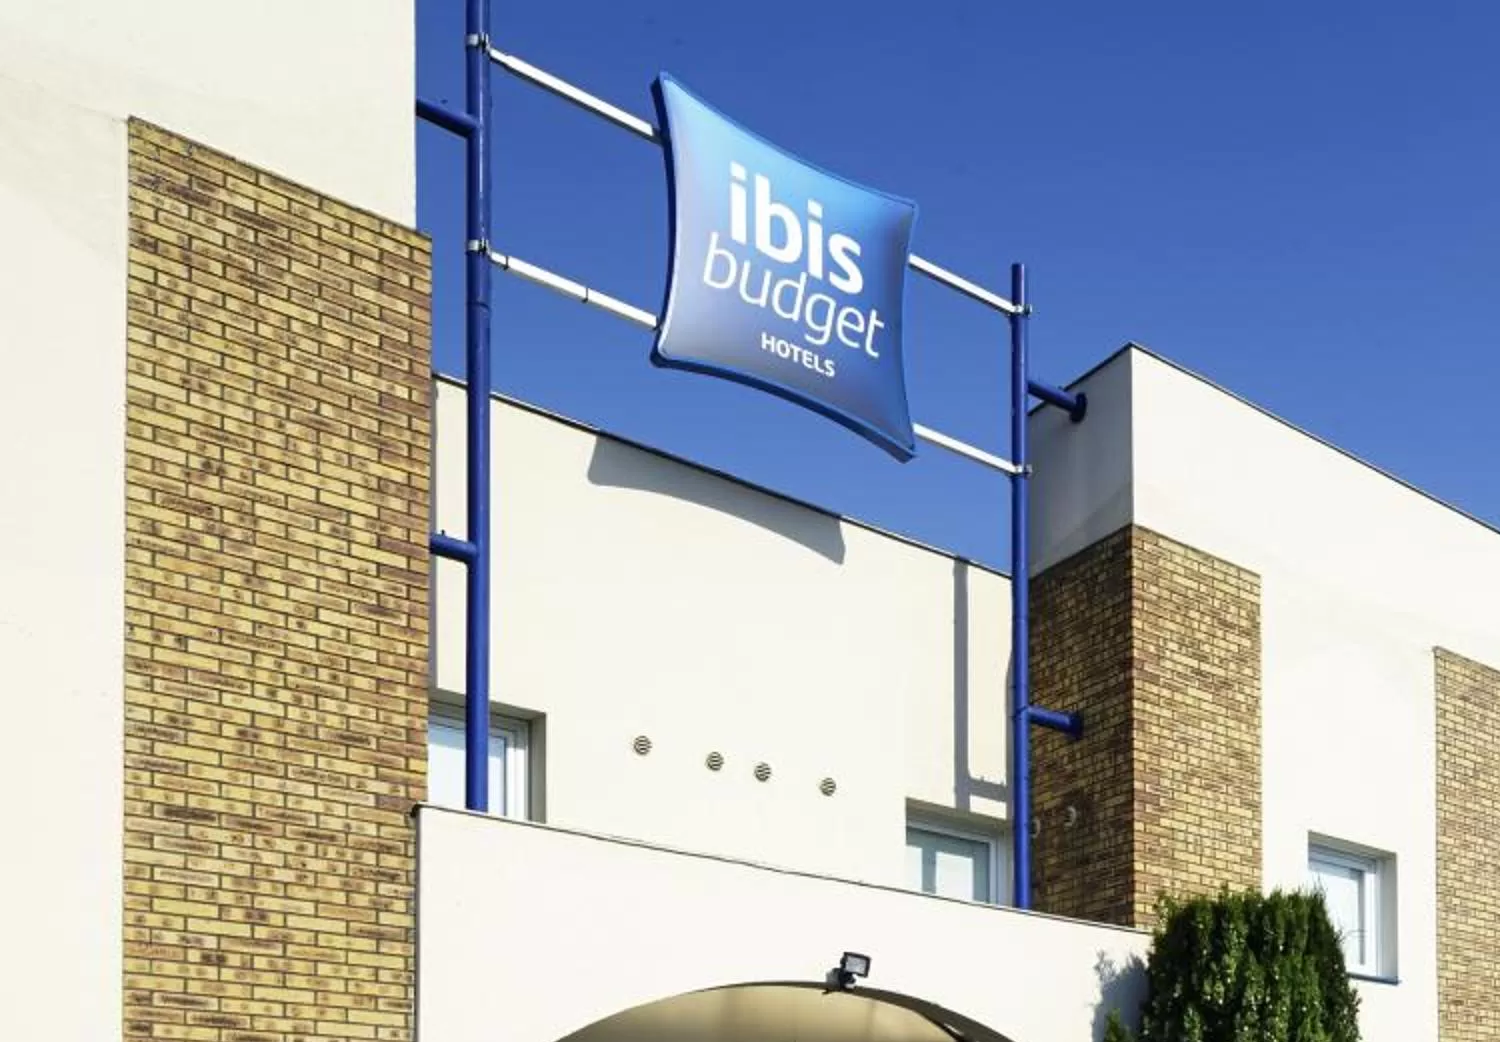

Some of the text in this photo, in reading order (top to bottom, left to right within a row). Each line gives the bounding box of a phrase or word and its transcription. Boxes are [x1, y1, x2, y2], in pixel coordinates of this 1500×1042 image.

[730, 161, 863, 294] ibis
[703, 231, 885, 358] budget
[761, 331, 836, 377] HOTELS
